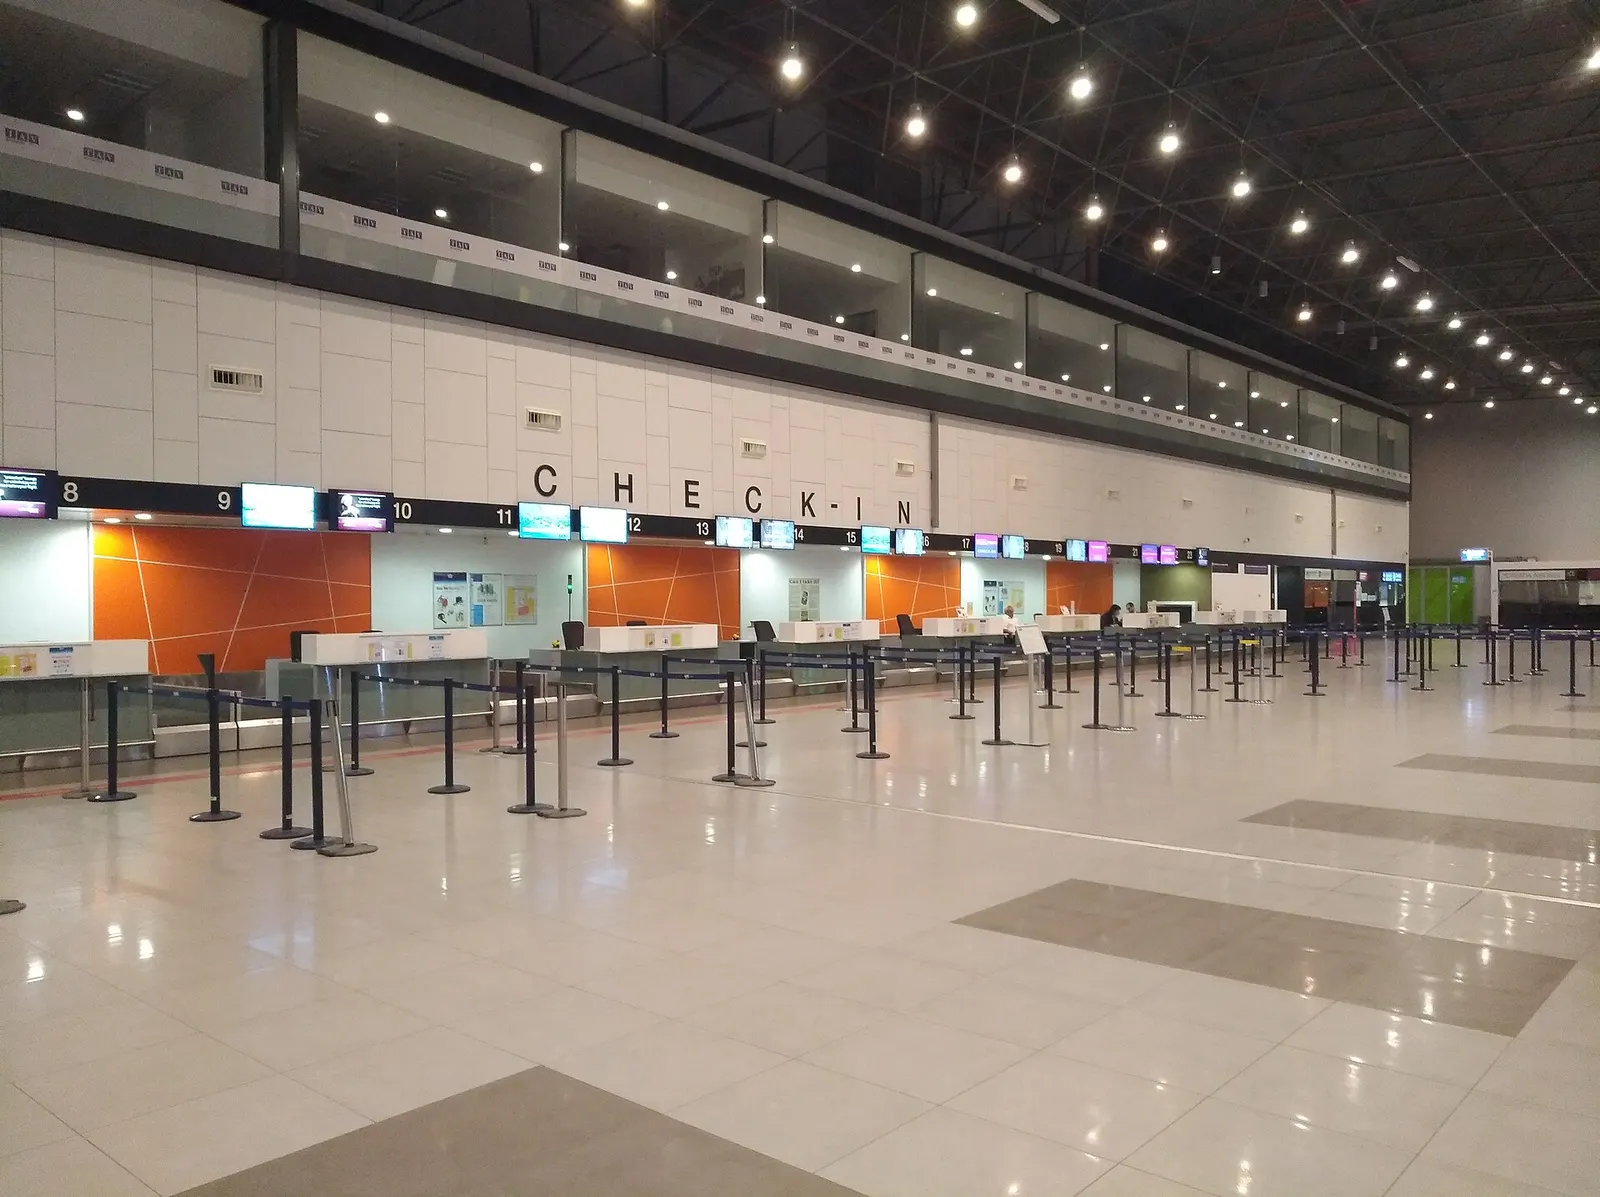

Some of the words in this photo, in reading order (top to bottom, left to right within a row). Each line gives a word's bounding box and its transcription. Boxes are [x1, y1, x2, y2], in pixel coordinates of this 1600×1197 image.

[353, 215, 377, 228] TAV
[401, 227, 423, 240] TAV
[449, 239, 470, 251] TAV
[496, 250, 515, 261] TAV
[63, 481, 79, 503] 8
[534, 463, 910, 525] CHECK-IN
[218, 491, 231, 510] 9
[393, 502, 412, 520] 10
[496, 508, 512, 525] 11
[627, 517, 641, 532] 12
[696, 521, 709, 536] 13
[794, 528, 804, 541] 14
[846, 531, 857, 544] 15
[962, 538, 970, 549] 17
